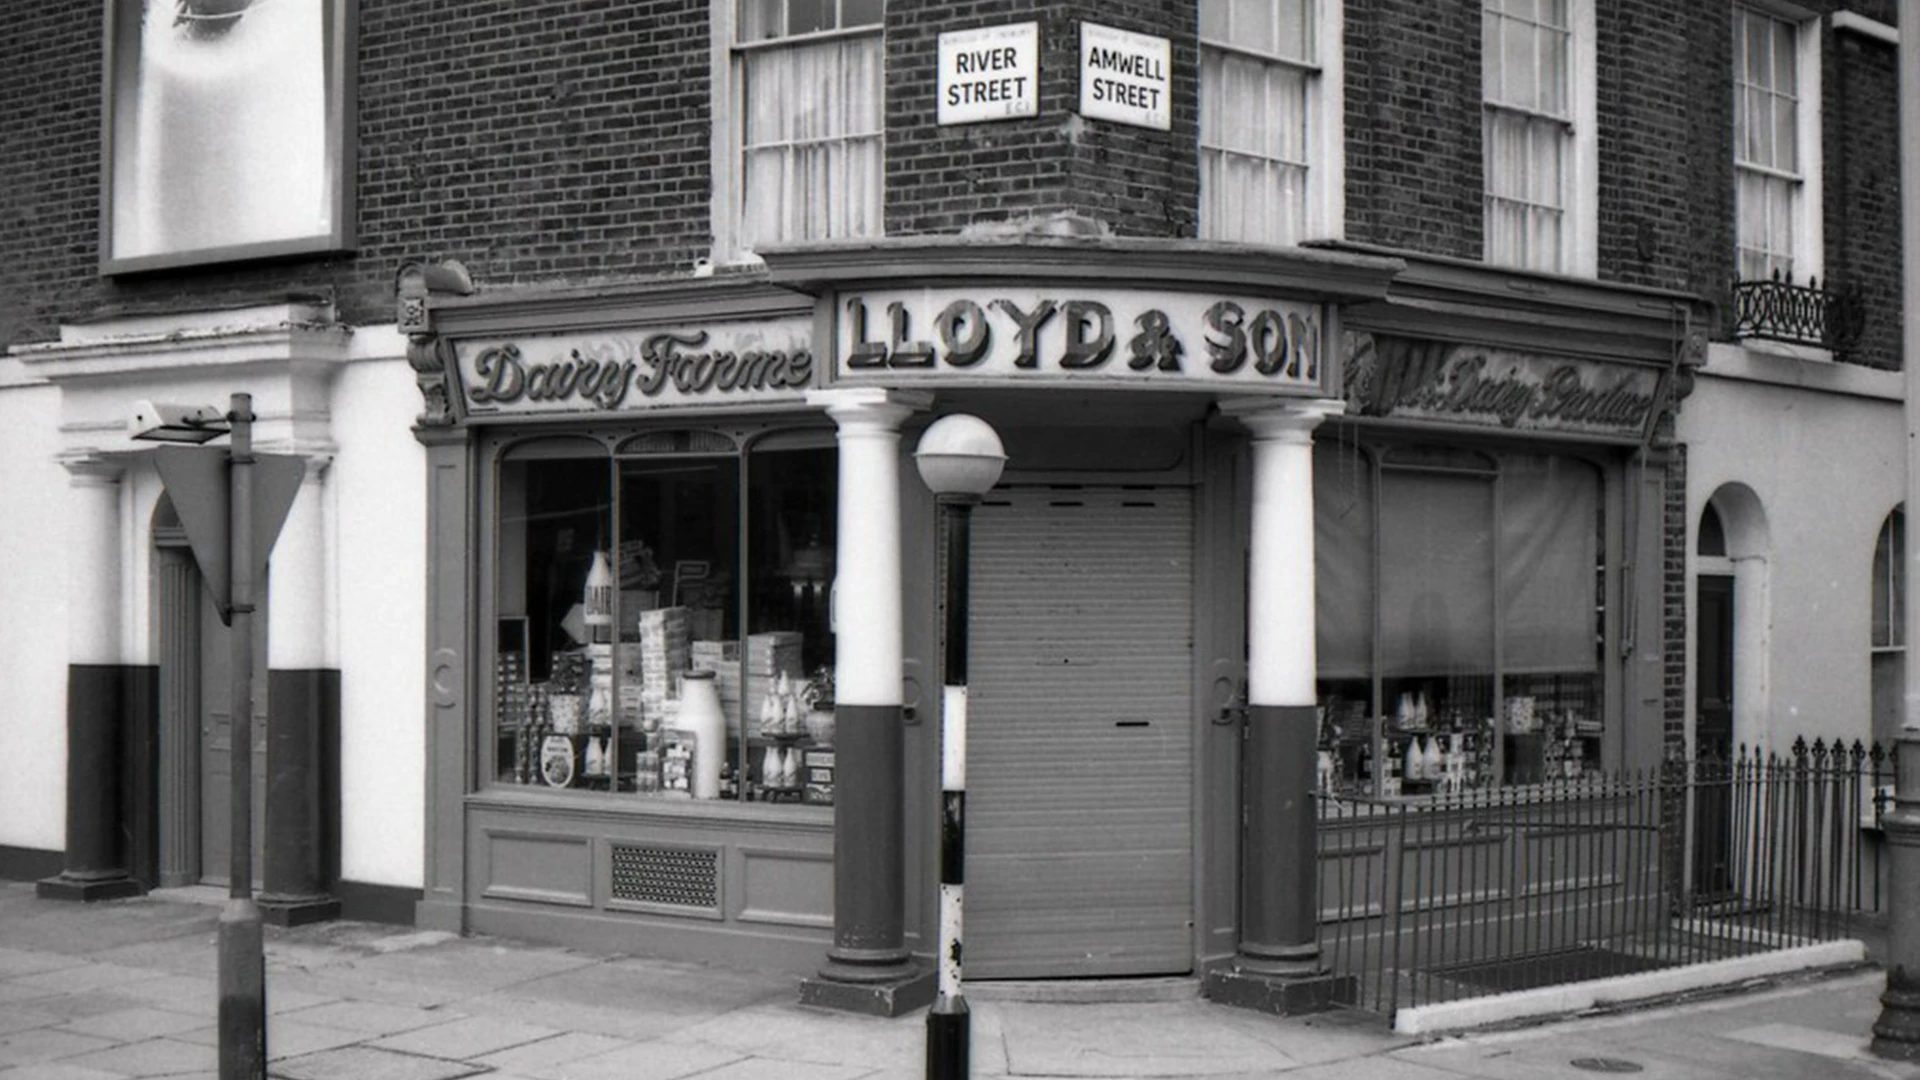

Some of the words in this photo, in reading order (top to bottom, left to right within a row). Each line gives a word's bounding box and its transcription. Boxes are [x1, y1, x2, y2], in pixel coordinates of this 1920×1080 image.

[956, 47, 1017, 74] RIVER
[1088, 46, 1165, 82] AMWELL
[948, 77, 1027, 106] STREET
[1093, 78, 1161, 111] STREET
[847, 296, 1115, 371] LLOYD
[1127, 309, 1184, 373] &
[1203, 299, 1320, 381] SON
[469, 342, 637, 410] Dairy
[1447, 354, 1542, 428] Dairy
